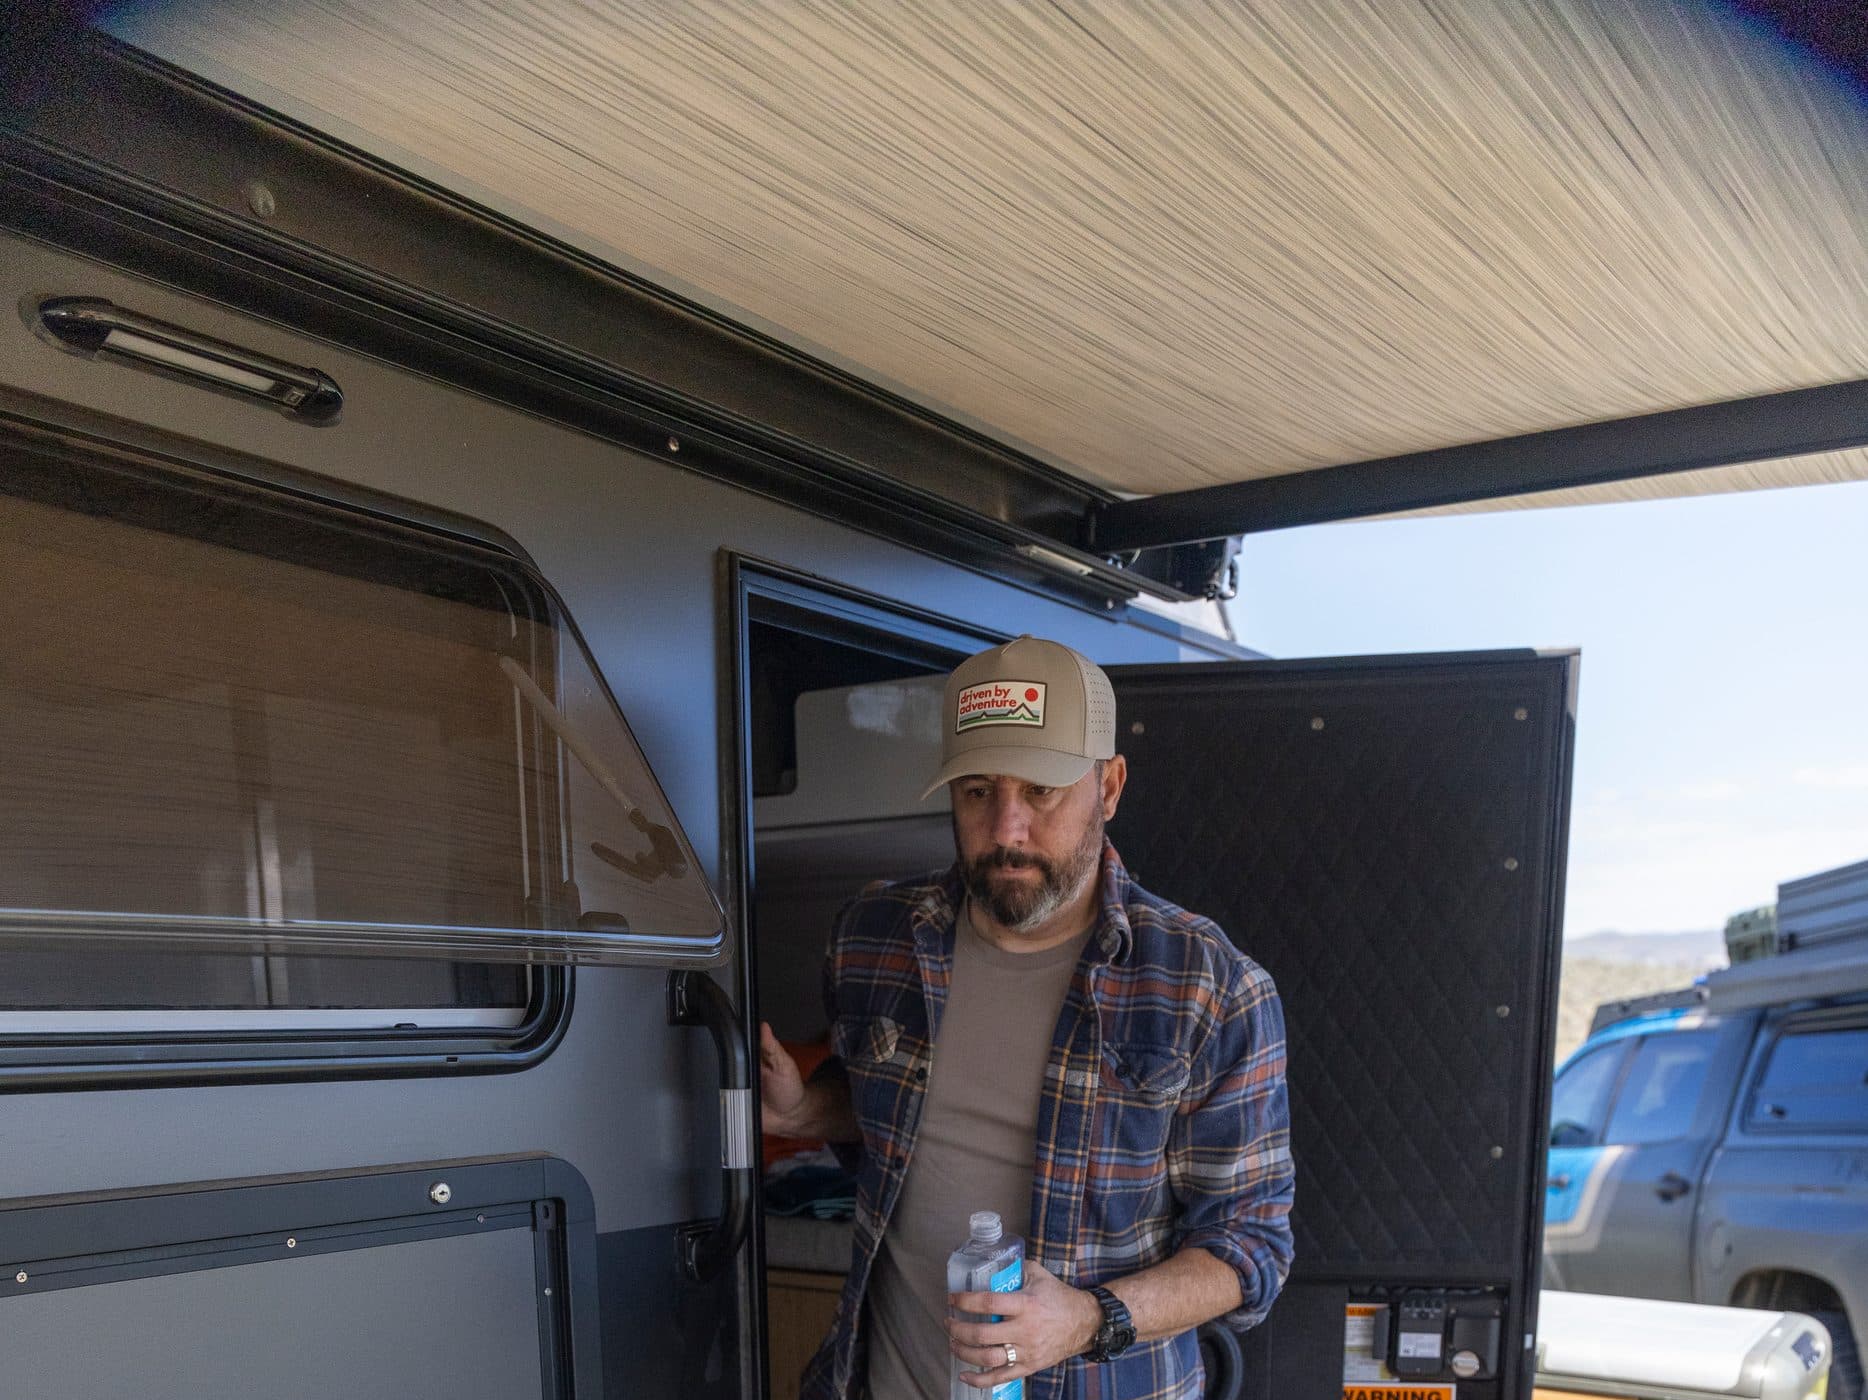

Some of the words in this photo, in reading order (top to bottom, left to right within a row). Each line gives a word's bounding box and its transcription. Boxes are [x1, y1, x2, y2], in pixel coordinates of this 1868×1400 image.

[960, 689, 992, 705] driven
[994, 684, 1012, 699] by
[959, 698, 1017, 715] adventure
[994, 1275, 1021, 1293] COS
